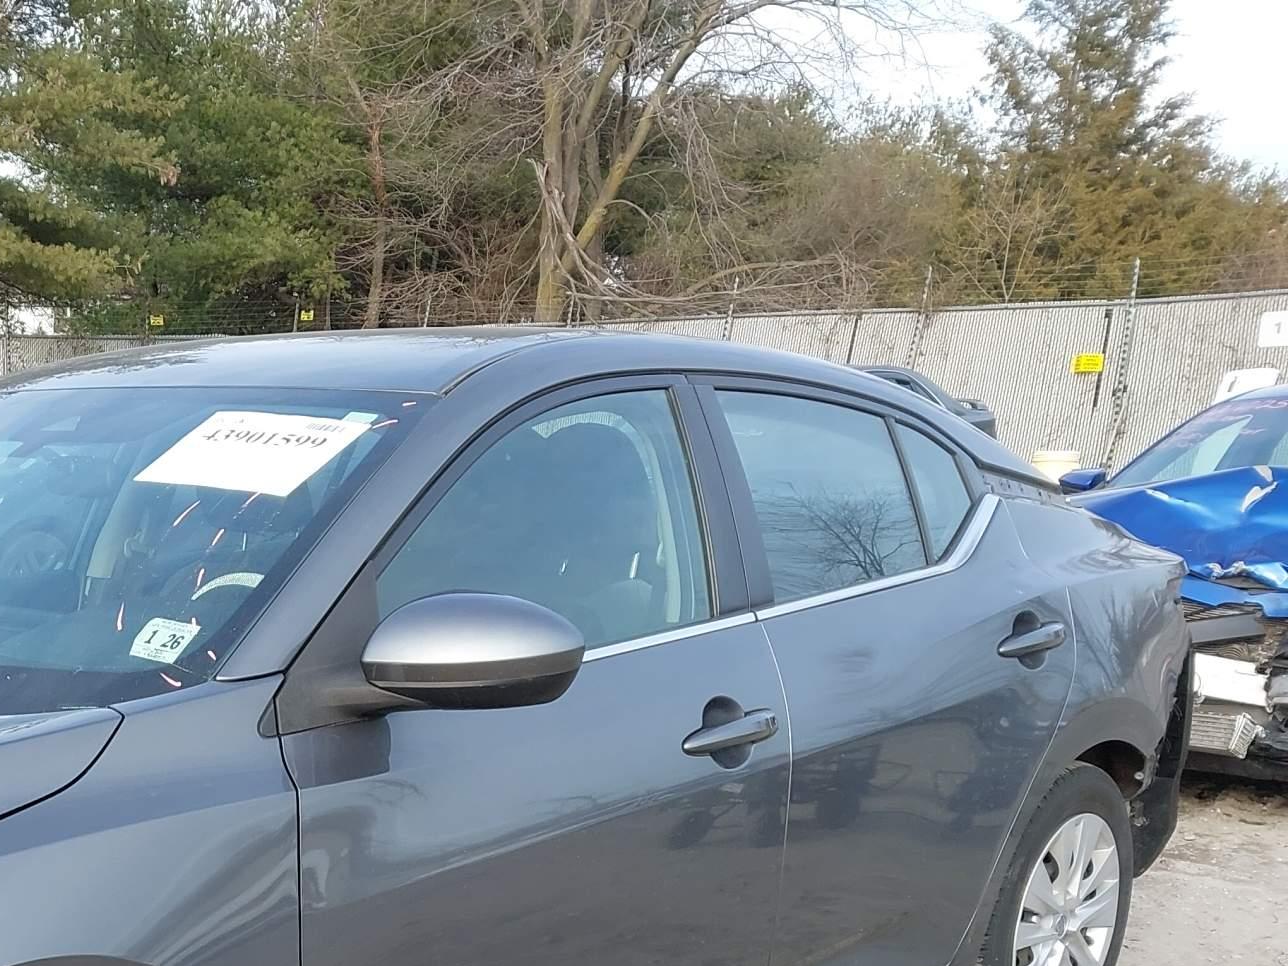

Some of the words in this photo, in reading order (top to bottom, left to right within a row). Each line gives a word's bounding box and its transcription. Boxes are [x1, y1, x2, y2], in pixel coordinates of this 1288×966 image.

[201, 429, 327, 448] 43901599
[144, 630, 159, 644] 1
[160, 633, 184, 650] 26
